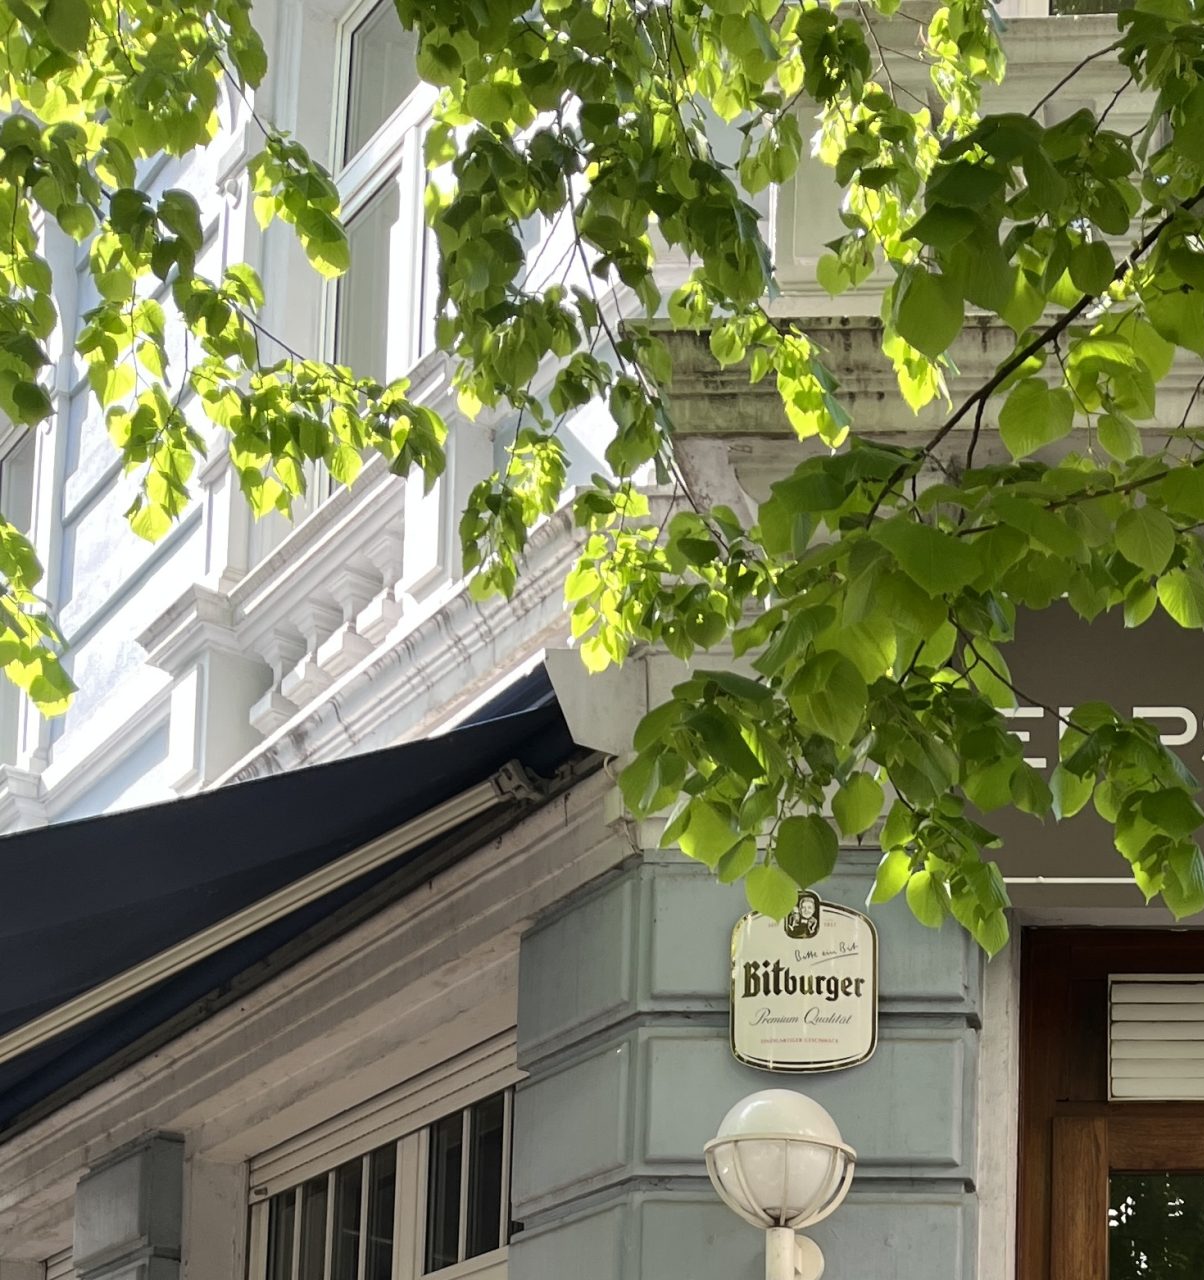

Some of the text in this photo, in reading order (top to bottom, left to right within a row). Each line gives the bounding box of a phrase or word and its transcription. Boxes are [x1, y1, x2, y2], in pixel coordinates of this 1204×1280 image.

[839, 941, 859, 953] Bit
[741, 959, 865, 1002] Bitburger
[750, 1007, 799, 1026] Premium
